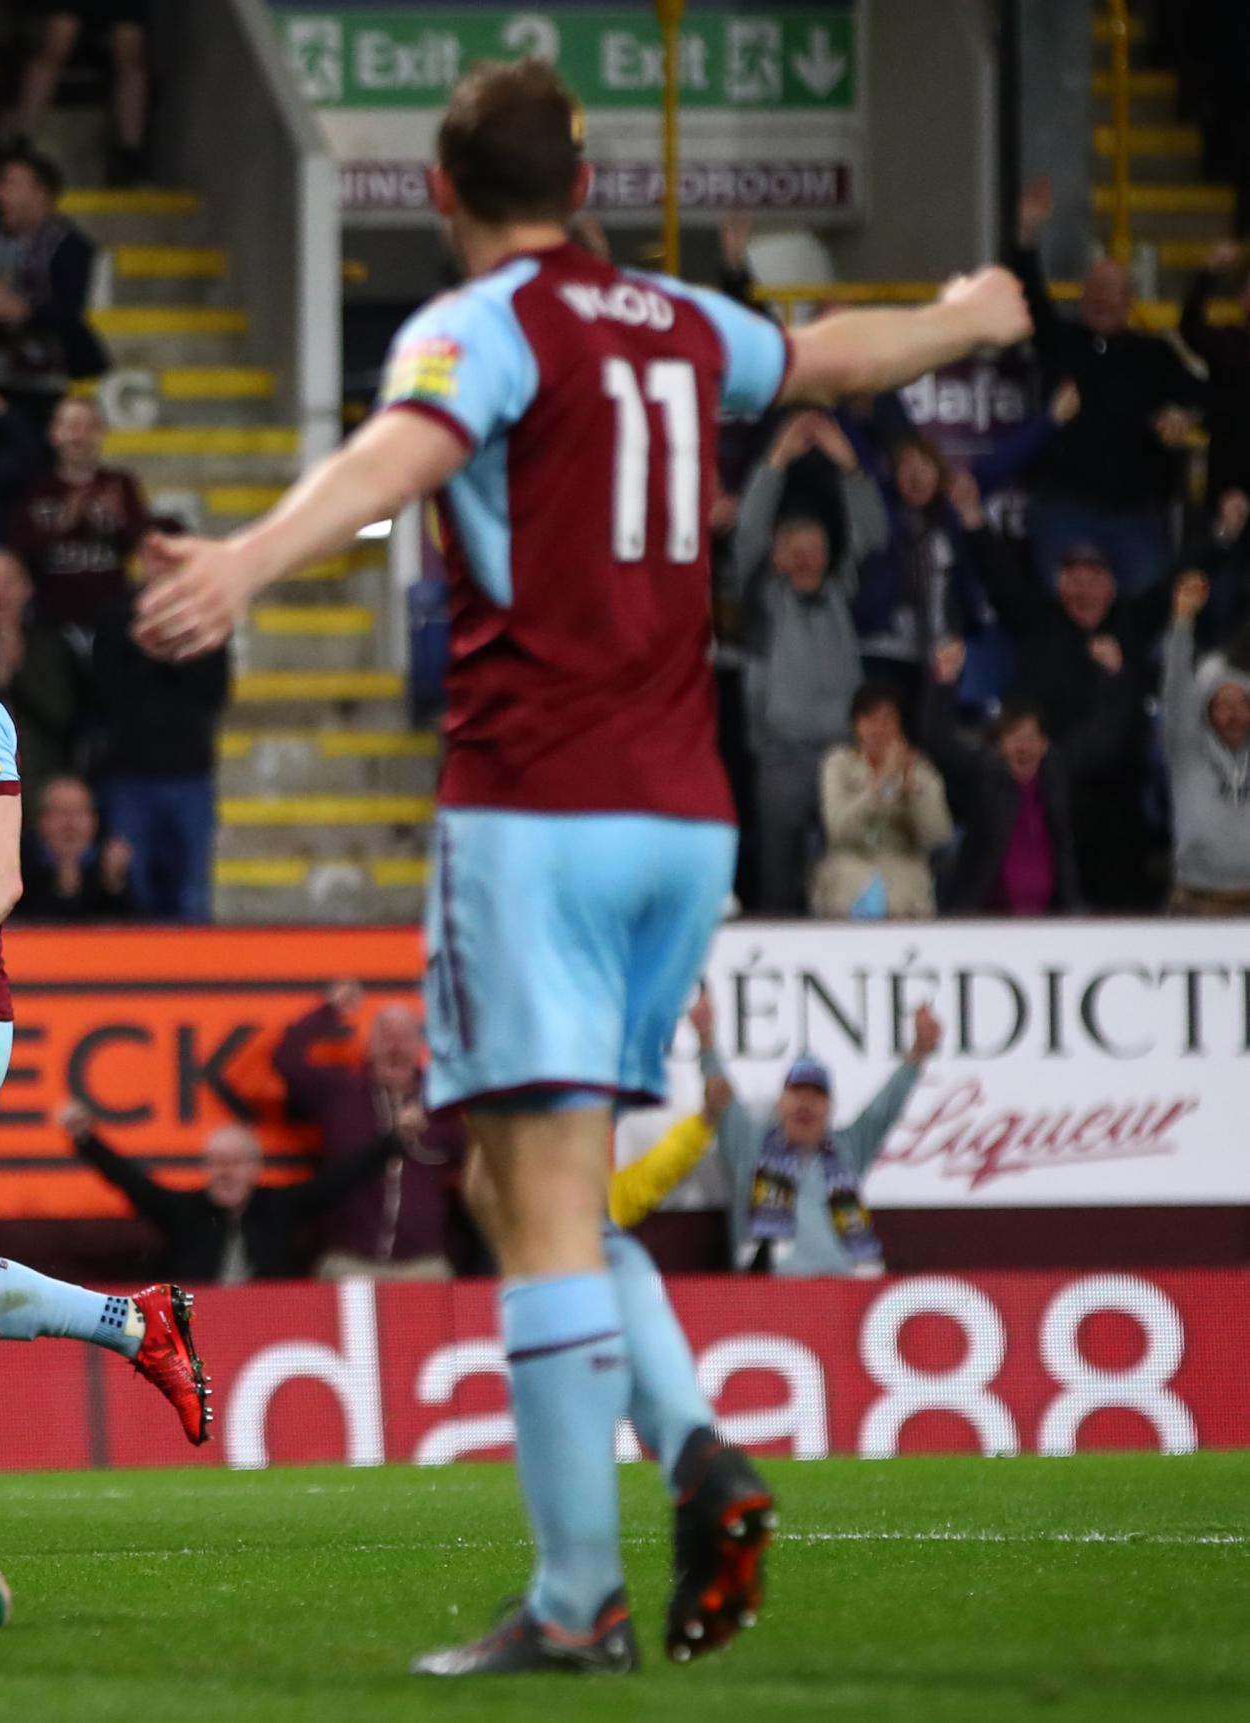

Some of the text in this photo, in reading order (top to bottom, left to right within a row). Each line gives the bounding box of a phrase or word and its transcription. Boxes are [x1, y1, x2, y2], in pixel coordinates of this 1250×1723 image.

[357, 30, 459, 88] Exit
[902, 366, 1024, 432] dafa
[602, 357, 700, 564] 11
[874, 1080, 1199, 1192] Liqueur
[227, 1272, 1200, 1469] daa88
